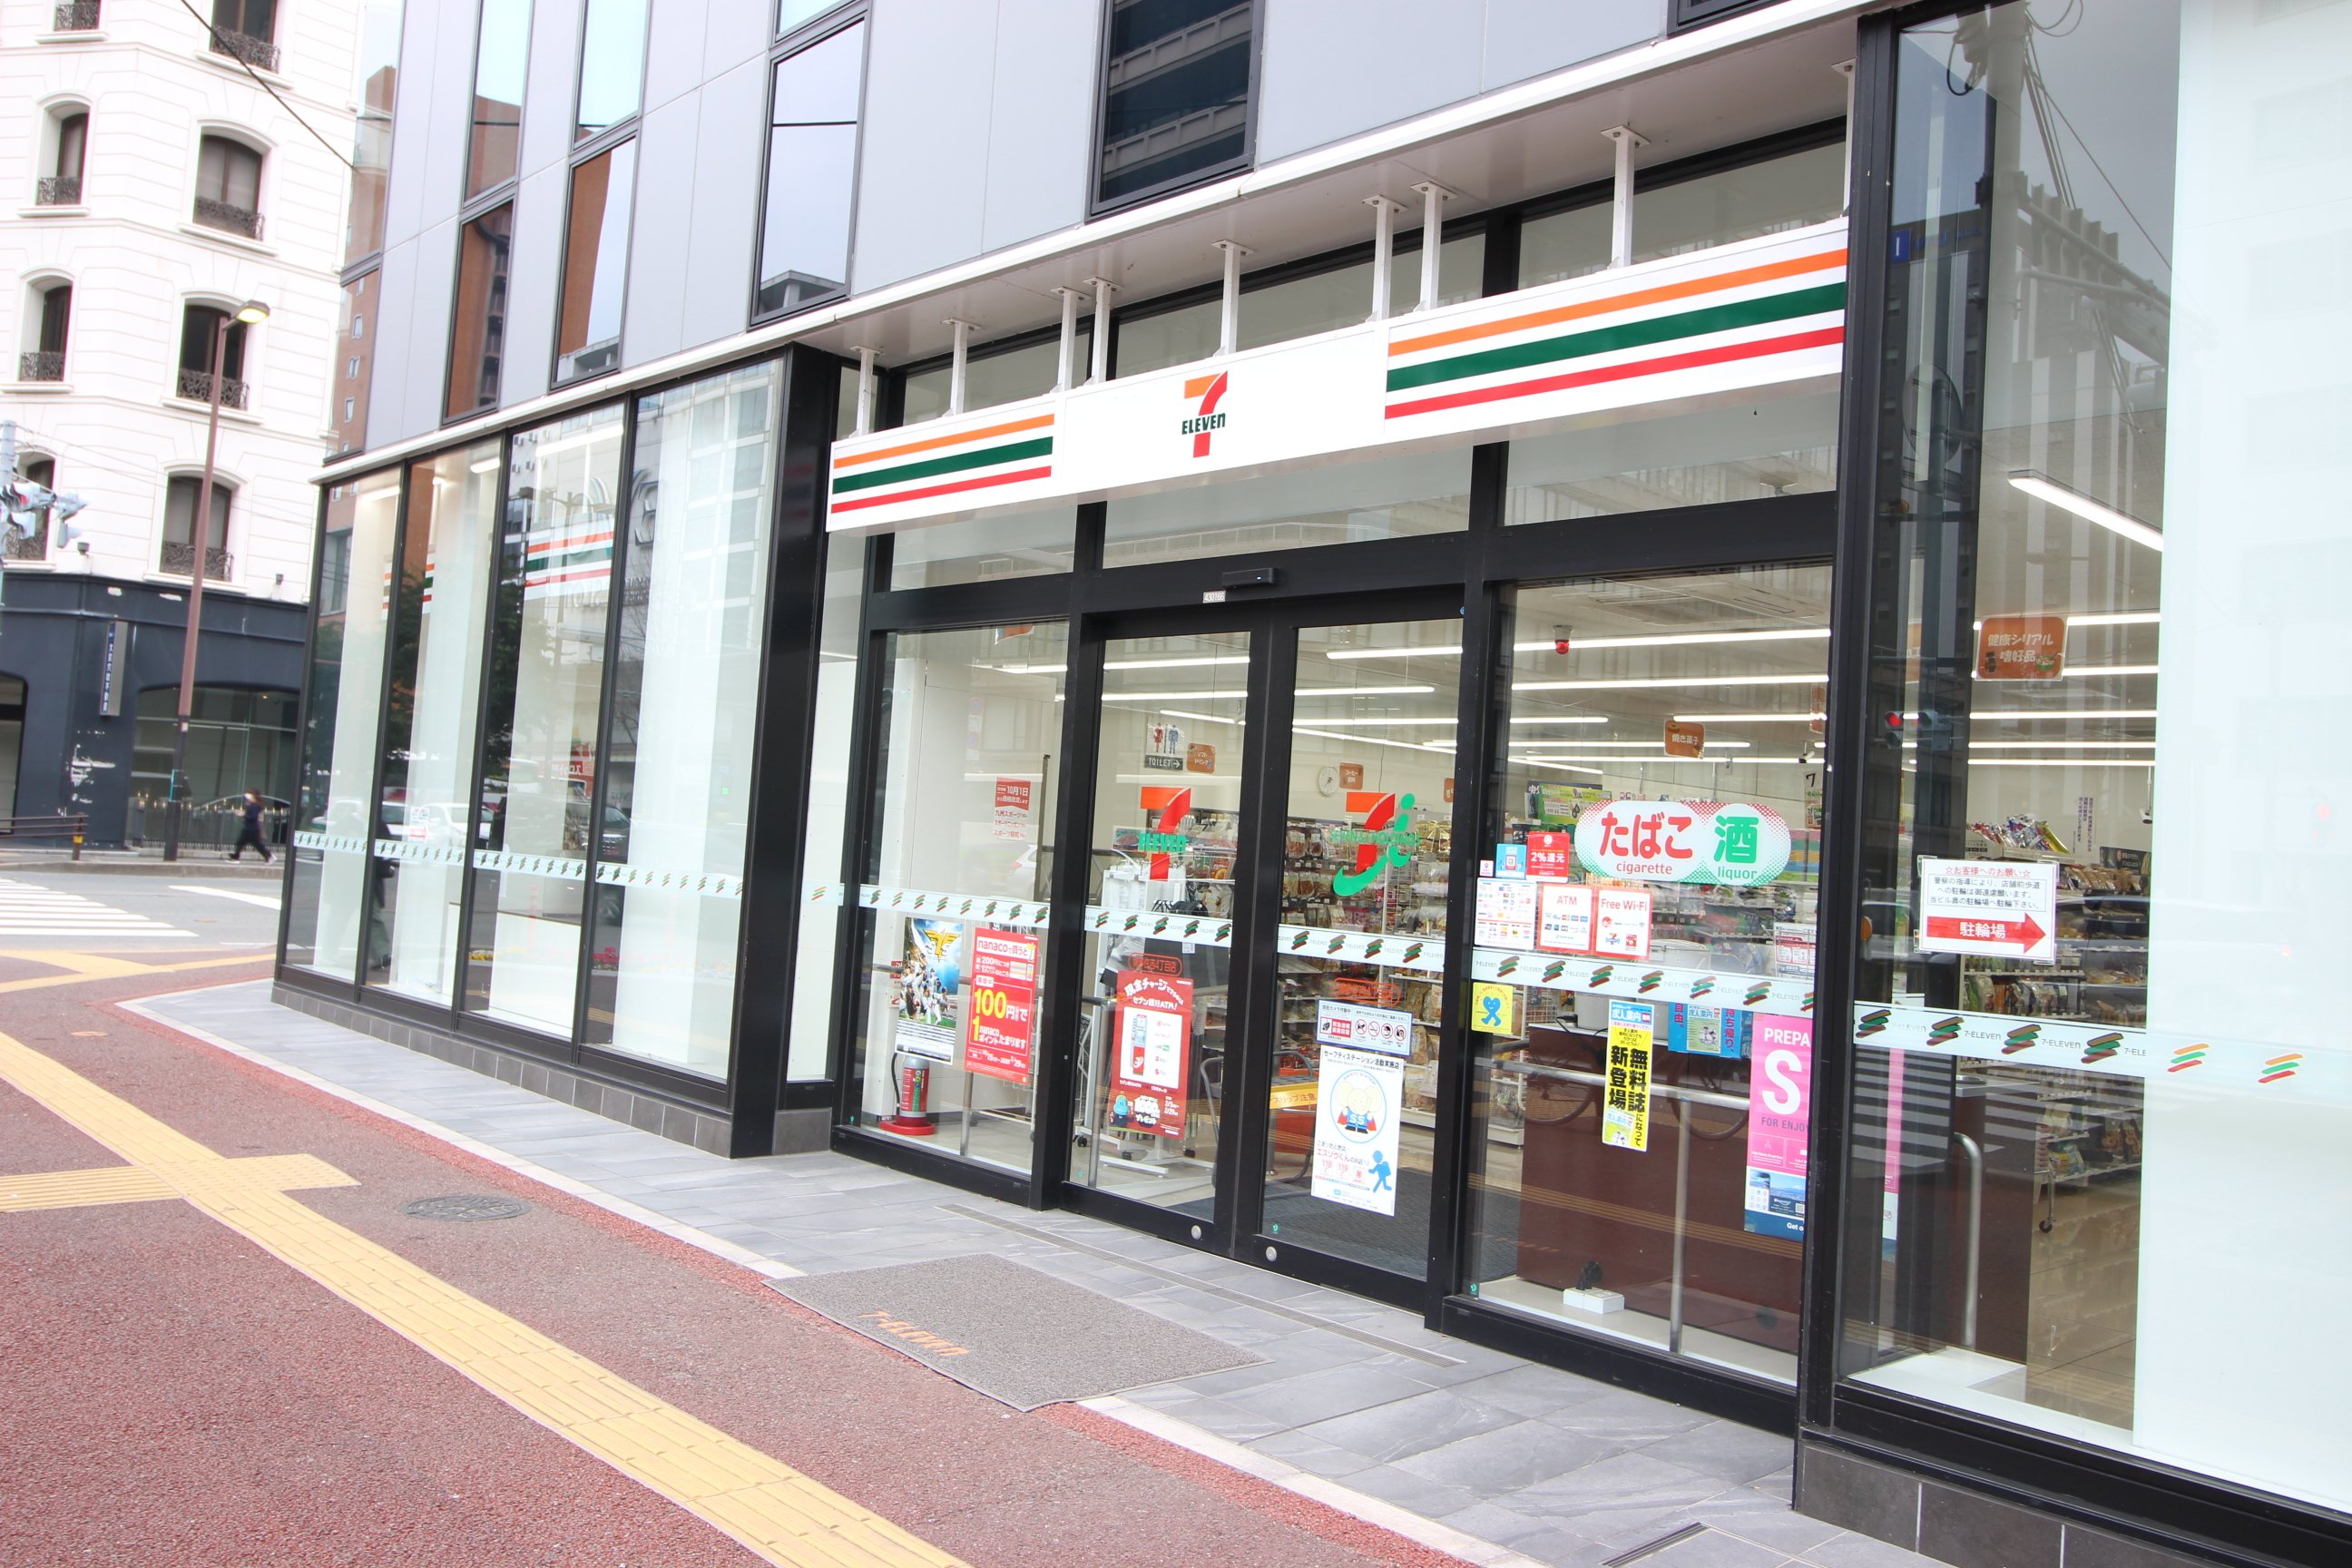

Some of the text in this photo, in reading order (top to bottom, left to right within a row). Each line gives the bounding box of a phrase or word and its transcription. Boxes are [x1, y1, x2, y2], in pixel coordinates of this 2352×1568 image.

[1184, 370, 1228, 457] 7
[1988, 633, 2053, 646] 健康シリアル
[2000, 650, 2036, 662] 嗜好品
[1148, 757, 1171, 768] TOILET
[1006, 786, 1029, 796] 10月1日
[1600, 811, 1693, 859] たばこ
[1714, 814, 1759, 864] 酒
[1616, 860, 1672, 877] cigarette
[1718, 866, 1758, 880] liquor
[1938, 887, 2032, 898] への駐輪は御遠慮願います。
[1556, 895, 1577, 906] ATM
[1601, 898, 1648, 912] Free Wi-Fi
[1930, 897, 2039, 909] 当ビル奥の駐輪場へ駐輪下さい。
[1959, 922, 2006, 939] 駐輪場
[1612, 1009, 1641, 1022] 求人案内
[1689, 1009, 1712, 1018] 求人案内
[1324, 1051, 1399, 1069] セーフティステーション活動実施店
[1609, 1045, 1629, 1111] 新登場
[1761, 1049, 1802, 1115] S
[1349, 1114, 1365, 1125] SS
[1761, 1117, 1779, 1128] FOR
[1787, 1222, 1798, 1230] Get
